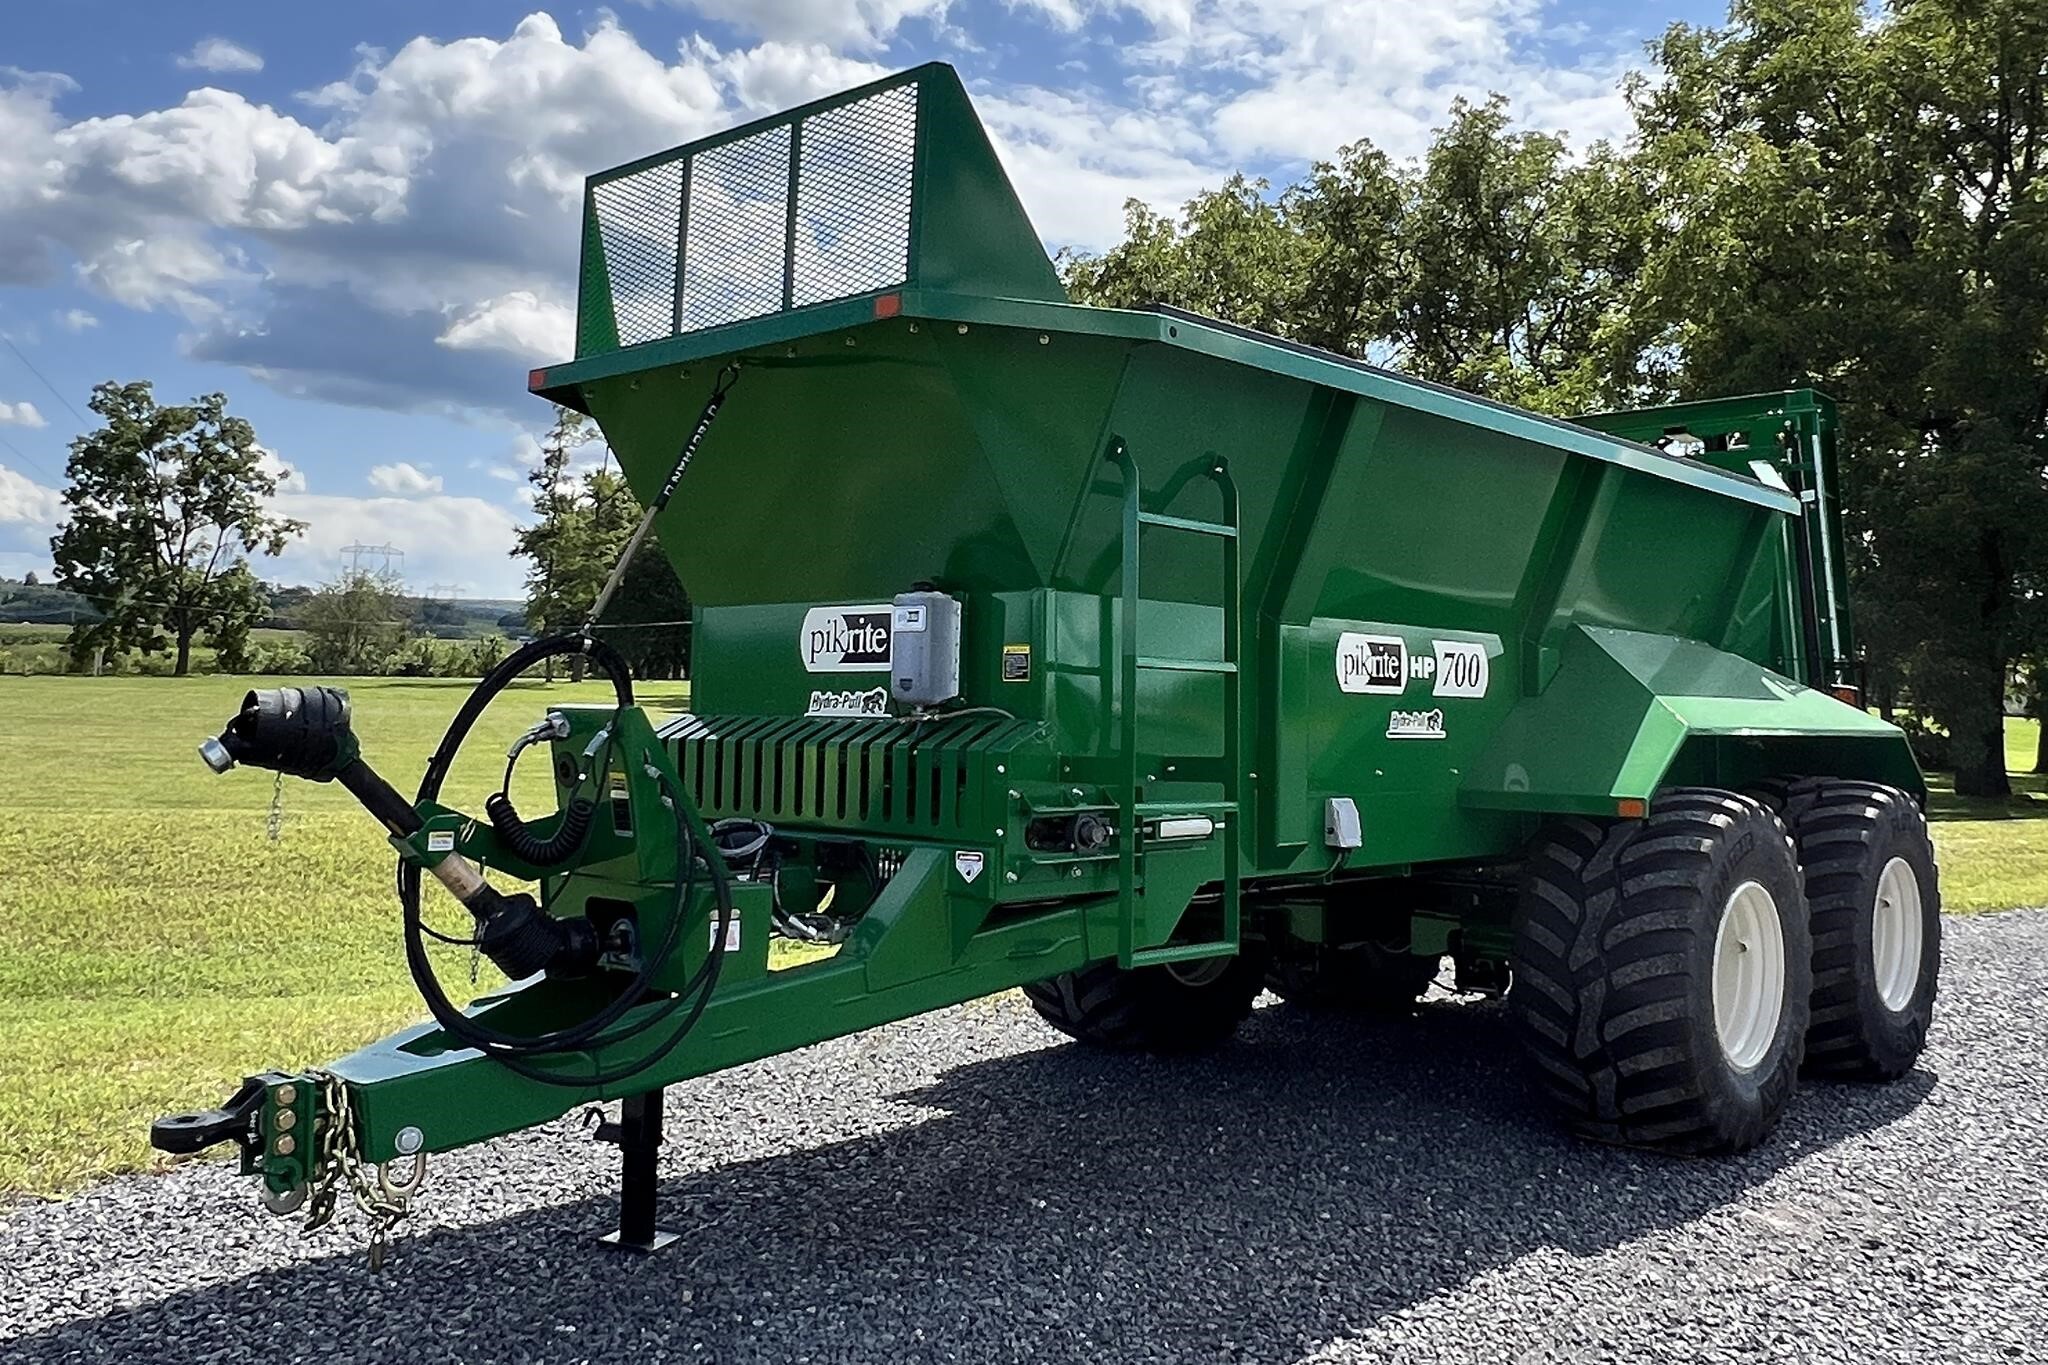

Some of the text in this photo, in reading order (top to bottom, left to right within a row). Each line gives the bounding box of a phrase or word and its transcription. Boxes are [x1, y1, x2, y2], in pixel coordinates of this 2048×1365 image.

[809, 617, 888, 665] pikrite
[1343, 645, 1480, 688] pikrite HP 700
[810, 692, 862, 713] Hydra-Pull
